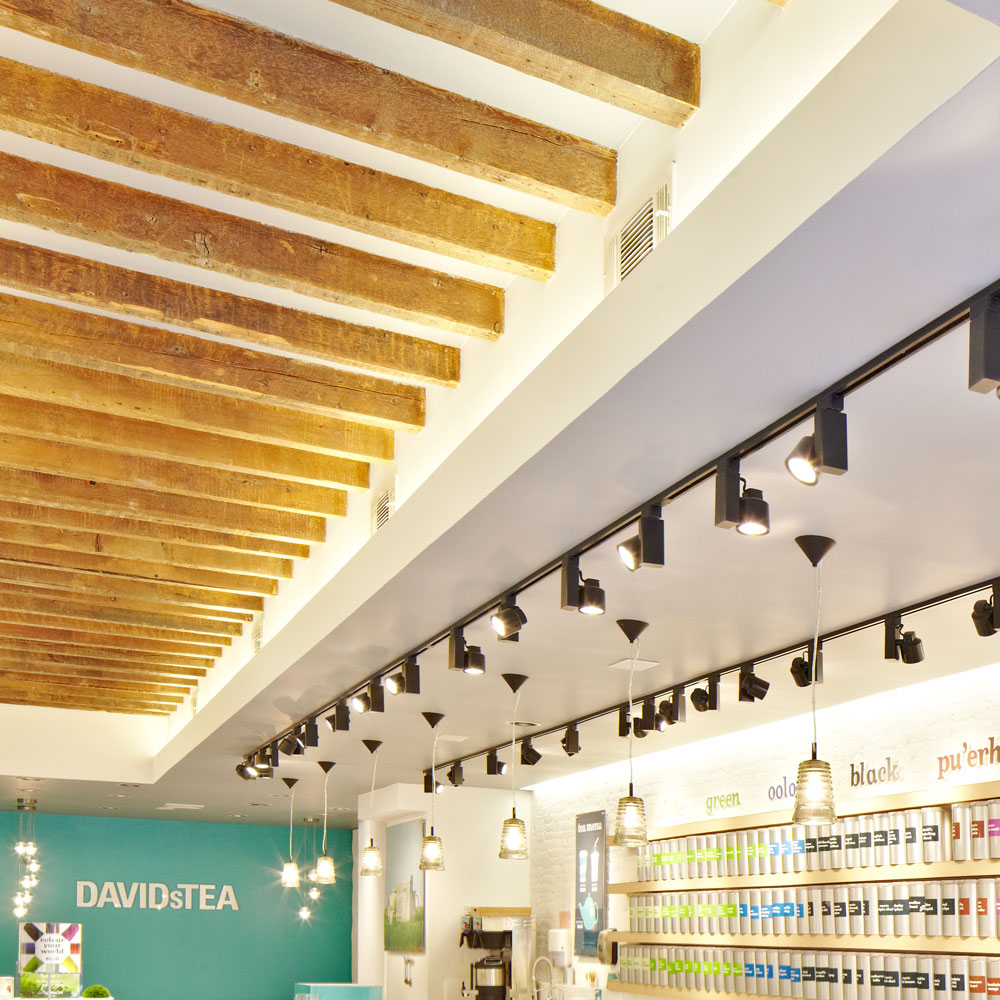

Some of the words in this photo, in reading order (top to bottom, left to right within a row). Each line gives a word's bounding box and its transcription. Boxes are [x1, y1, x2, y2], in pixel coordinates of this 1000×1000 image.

[850, 757, 899, 787] black
[768, 776, 797, 800] oolo
[706, 792, 741, 816] green
[76, 880, 239, 911] DAVIDsTEA
